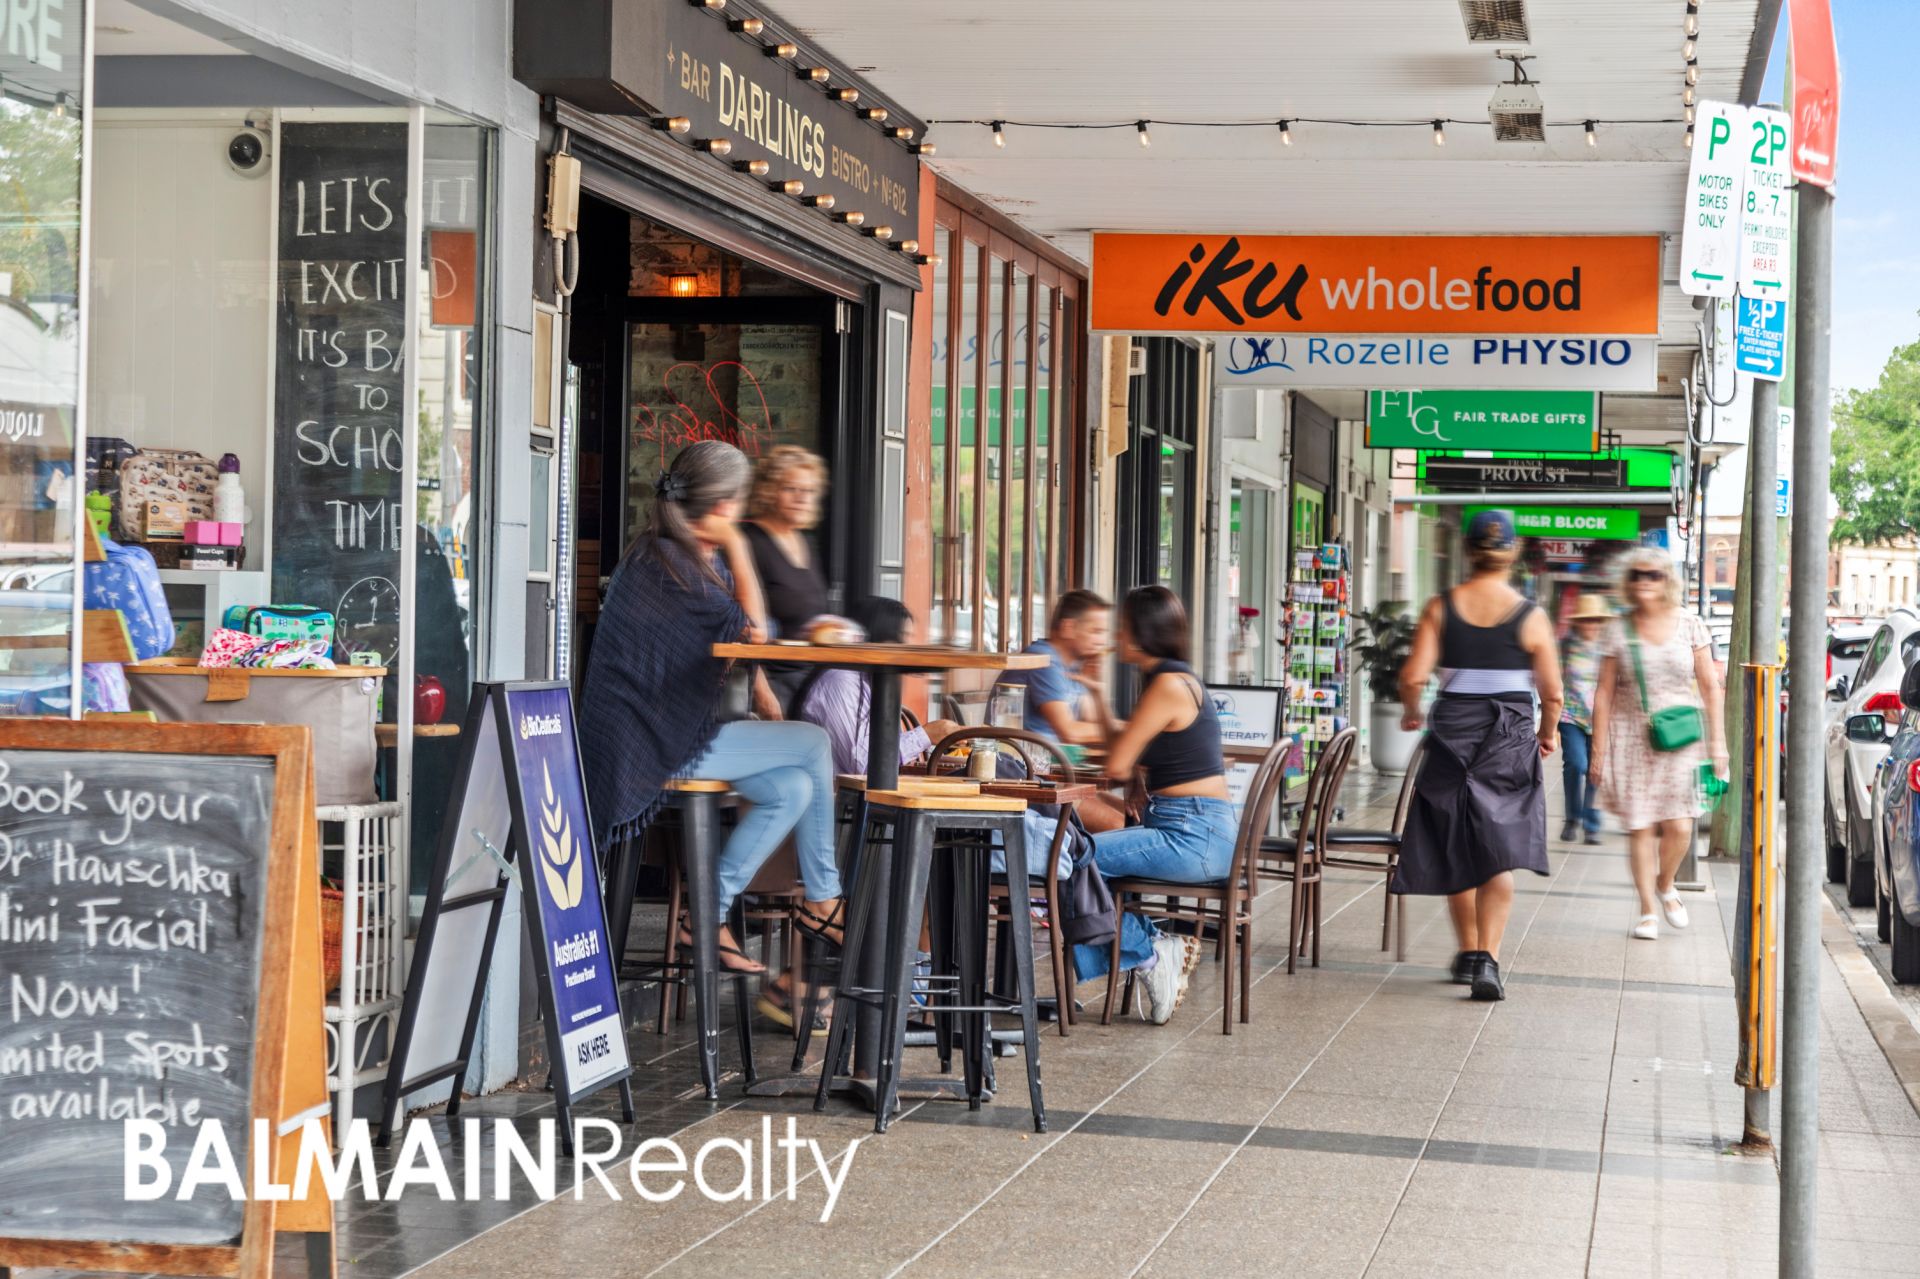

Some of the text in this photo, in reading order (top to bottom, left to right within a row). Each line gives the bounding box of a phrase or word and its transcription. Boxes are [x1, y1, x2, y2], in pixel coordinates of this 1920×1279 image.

[0, 0, 63, 72] RE
[681, 51, 710, 103] BAR
[719, 62, 825, 178] DARLINGS
[832, 145, 869, 193] BISTRO
[1708, 116, 1731, 160] P
[1750, 120, 1787, 166] 2P
[1699, 174, 1732, 190] MOTOR
[1753, 170, 1783, 189] TICKET
[296, 176, 394, 236] LET'S
[1699, 193, 1728, 210] BIKES
[1699, 213, 1726, 228] ONLY
[301, 257, 458, 304] EXCITD
[1155, 237, 1582, 325] iku wholefood
[298, 328, 348, 368] IT'S
[1307, 338, 1632, 366] Rozelle PHYSIO
[1739, 325, 1783, 342] FREE E-TICKET
[353, 383, 389, 411] TO
[1453, 411, 1586, 425] FAIR TRADE GIFTS
[1555, 516, 1608, 529] BLOCK
[99, 788, 210, 846] your
[53, 838, 233, 898] Hauschka
[77, 897, 209, 954] Facial
[554, 931, 591, 968] Australia's
[124, 1022, 230, 1080] Spots
[577, 1033, 611, 1067] ASK HERE
[10, 1077, 201, 1127] available
